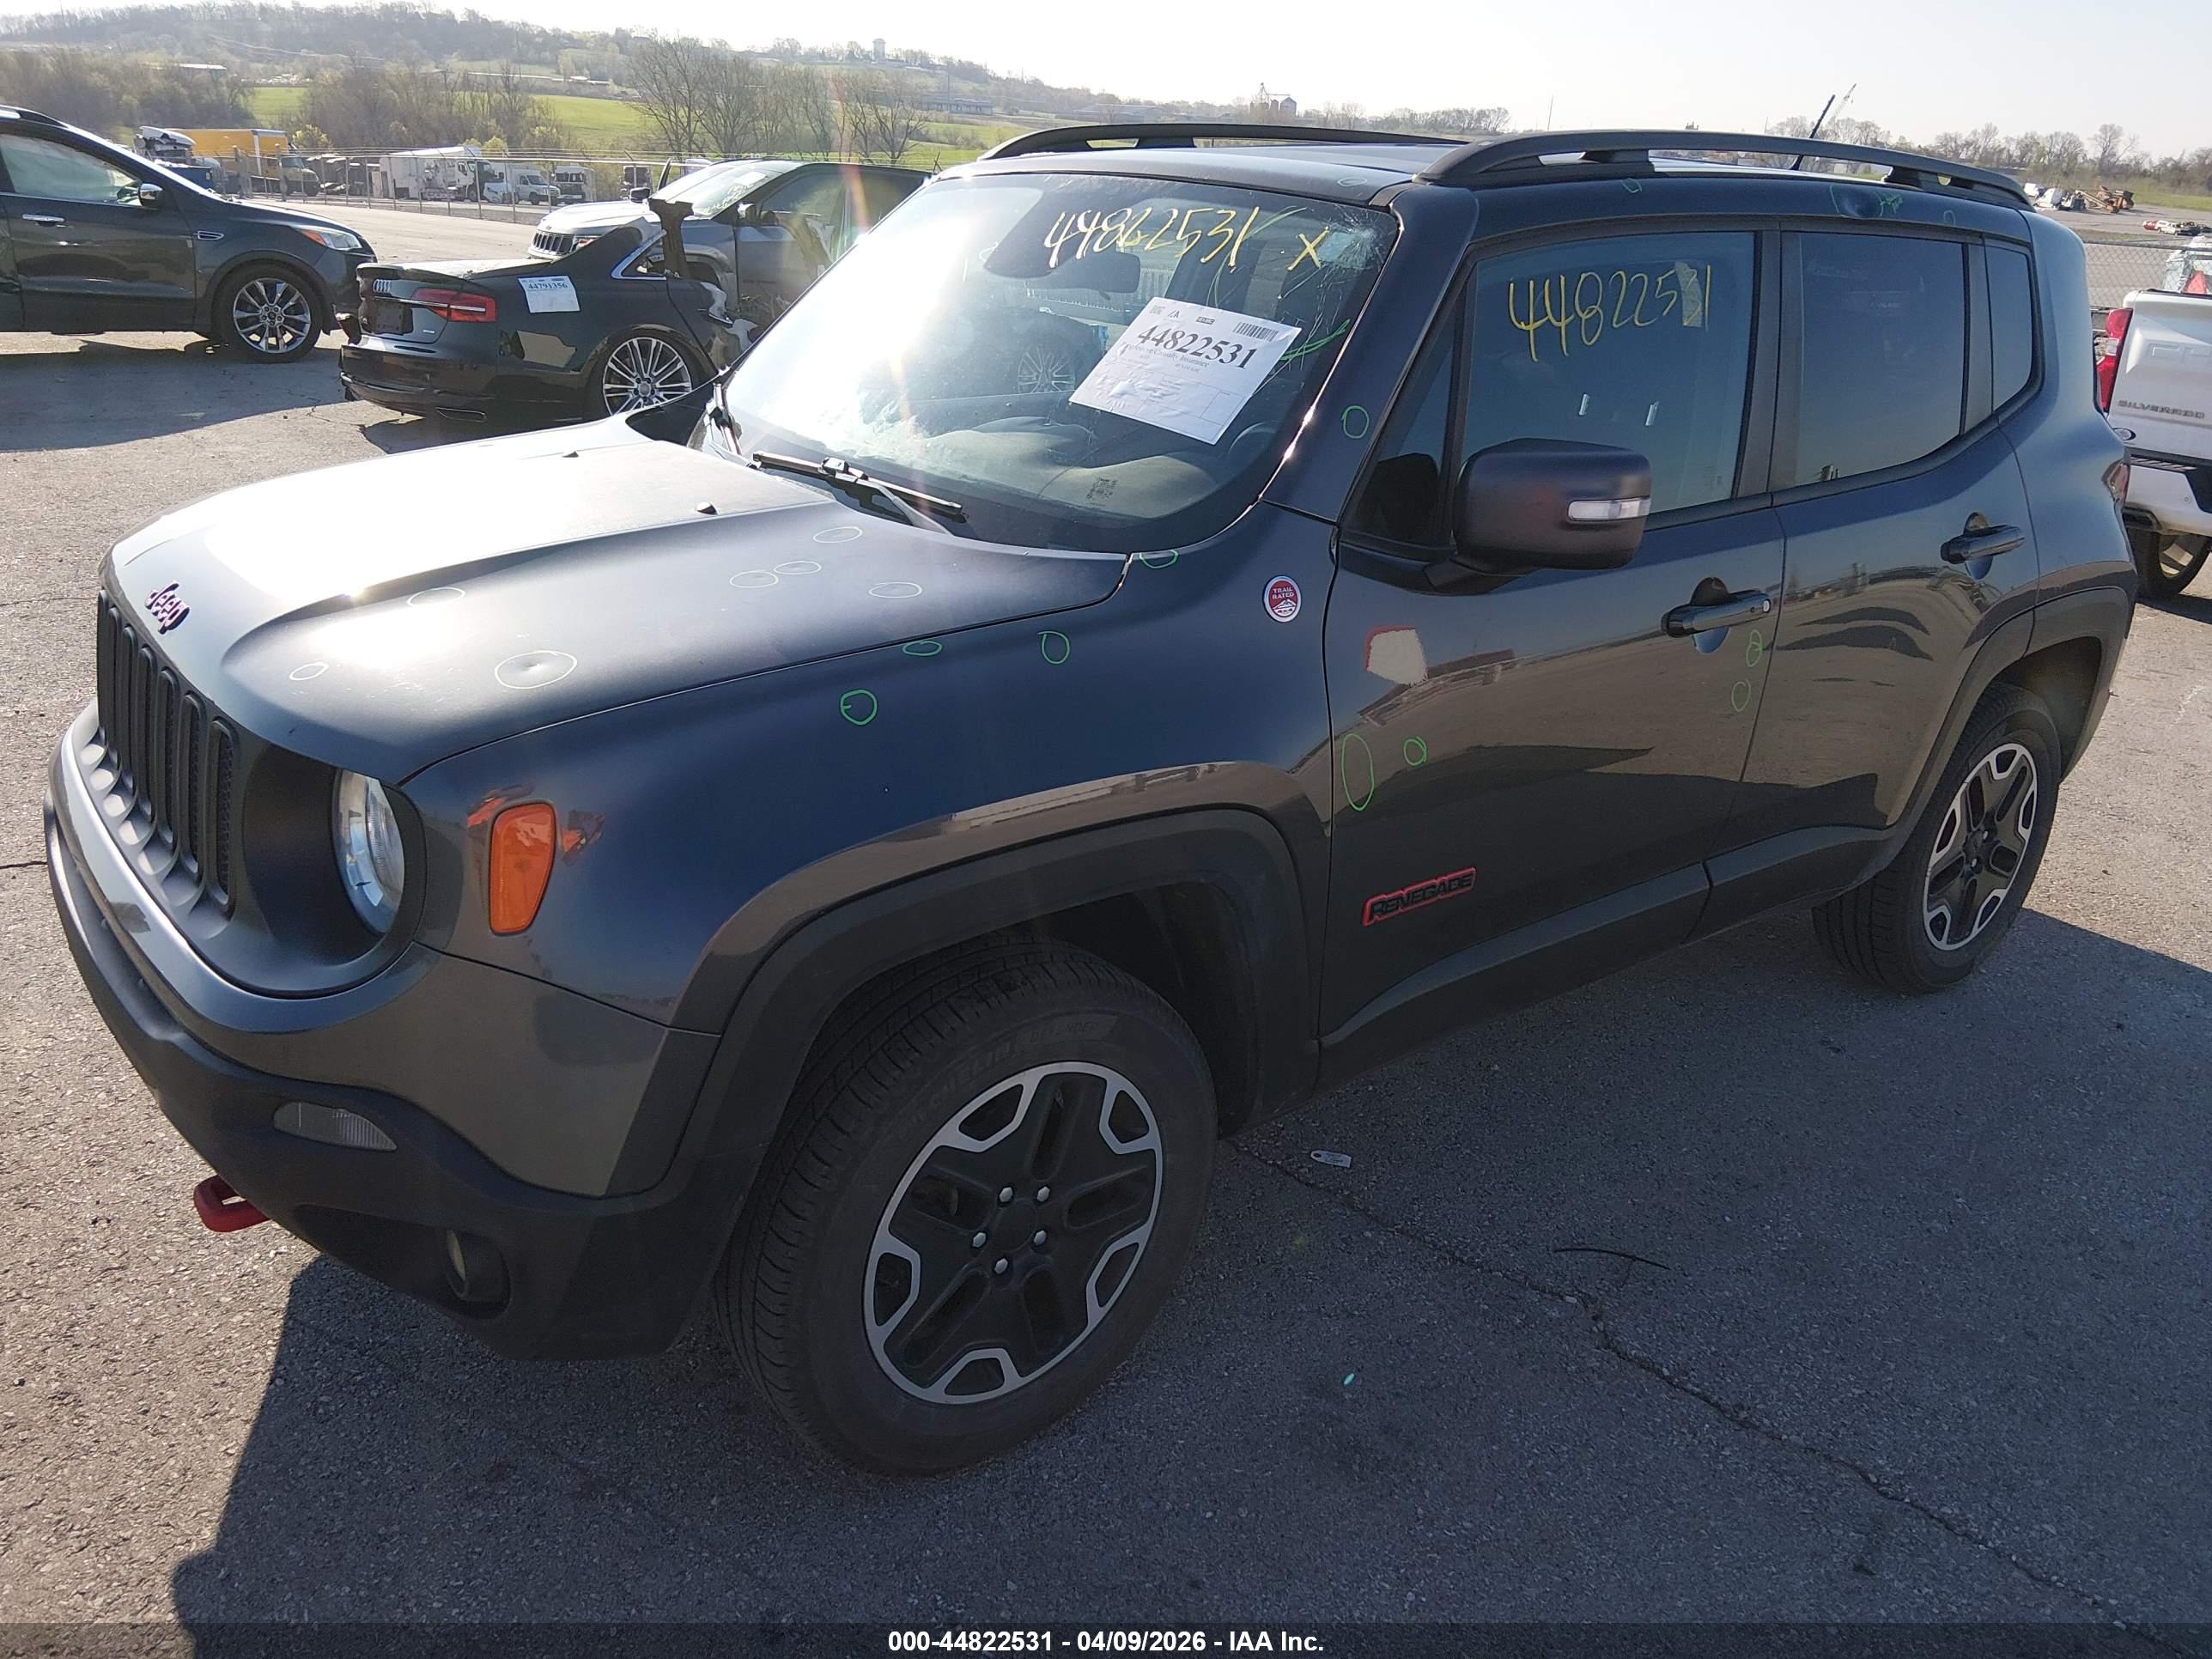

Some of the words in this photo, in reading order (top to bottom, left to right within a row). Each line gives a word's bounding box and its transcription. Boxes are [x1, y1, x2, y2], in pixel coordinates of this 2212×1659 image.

[1043, 207, 1259, 269] 44822531
[1509, 264, 1711, 362] 44822531
[1138, 325, 1257, 369] 44822531
[2118, 399, 2205, 419] SILVERADO
[145, 580, 190, 635] Jeep
[1364, 868, 1475, 925] RENEGADE
